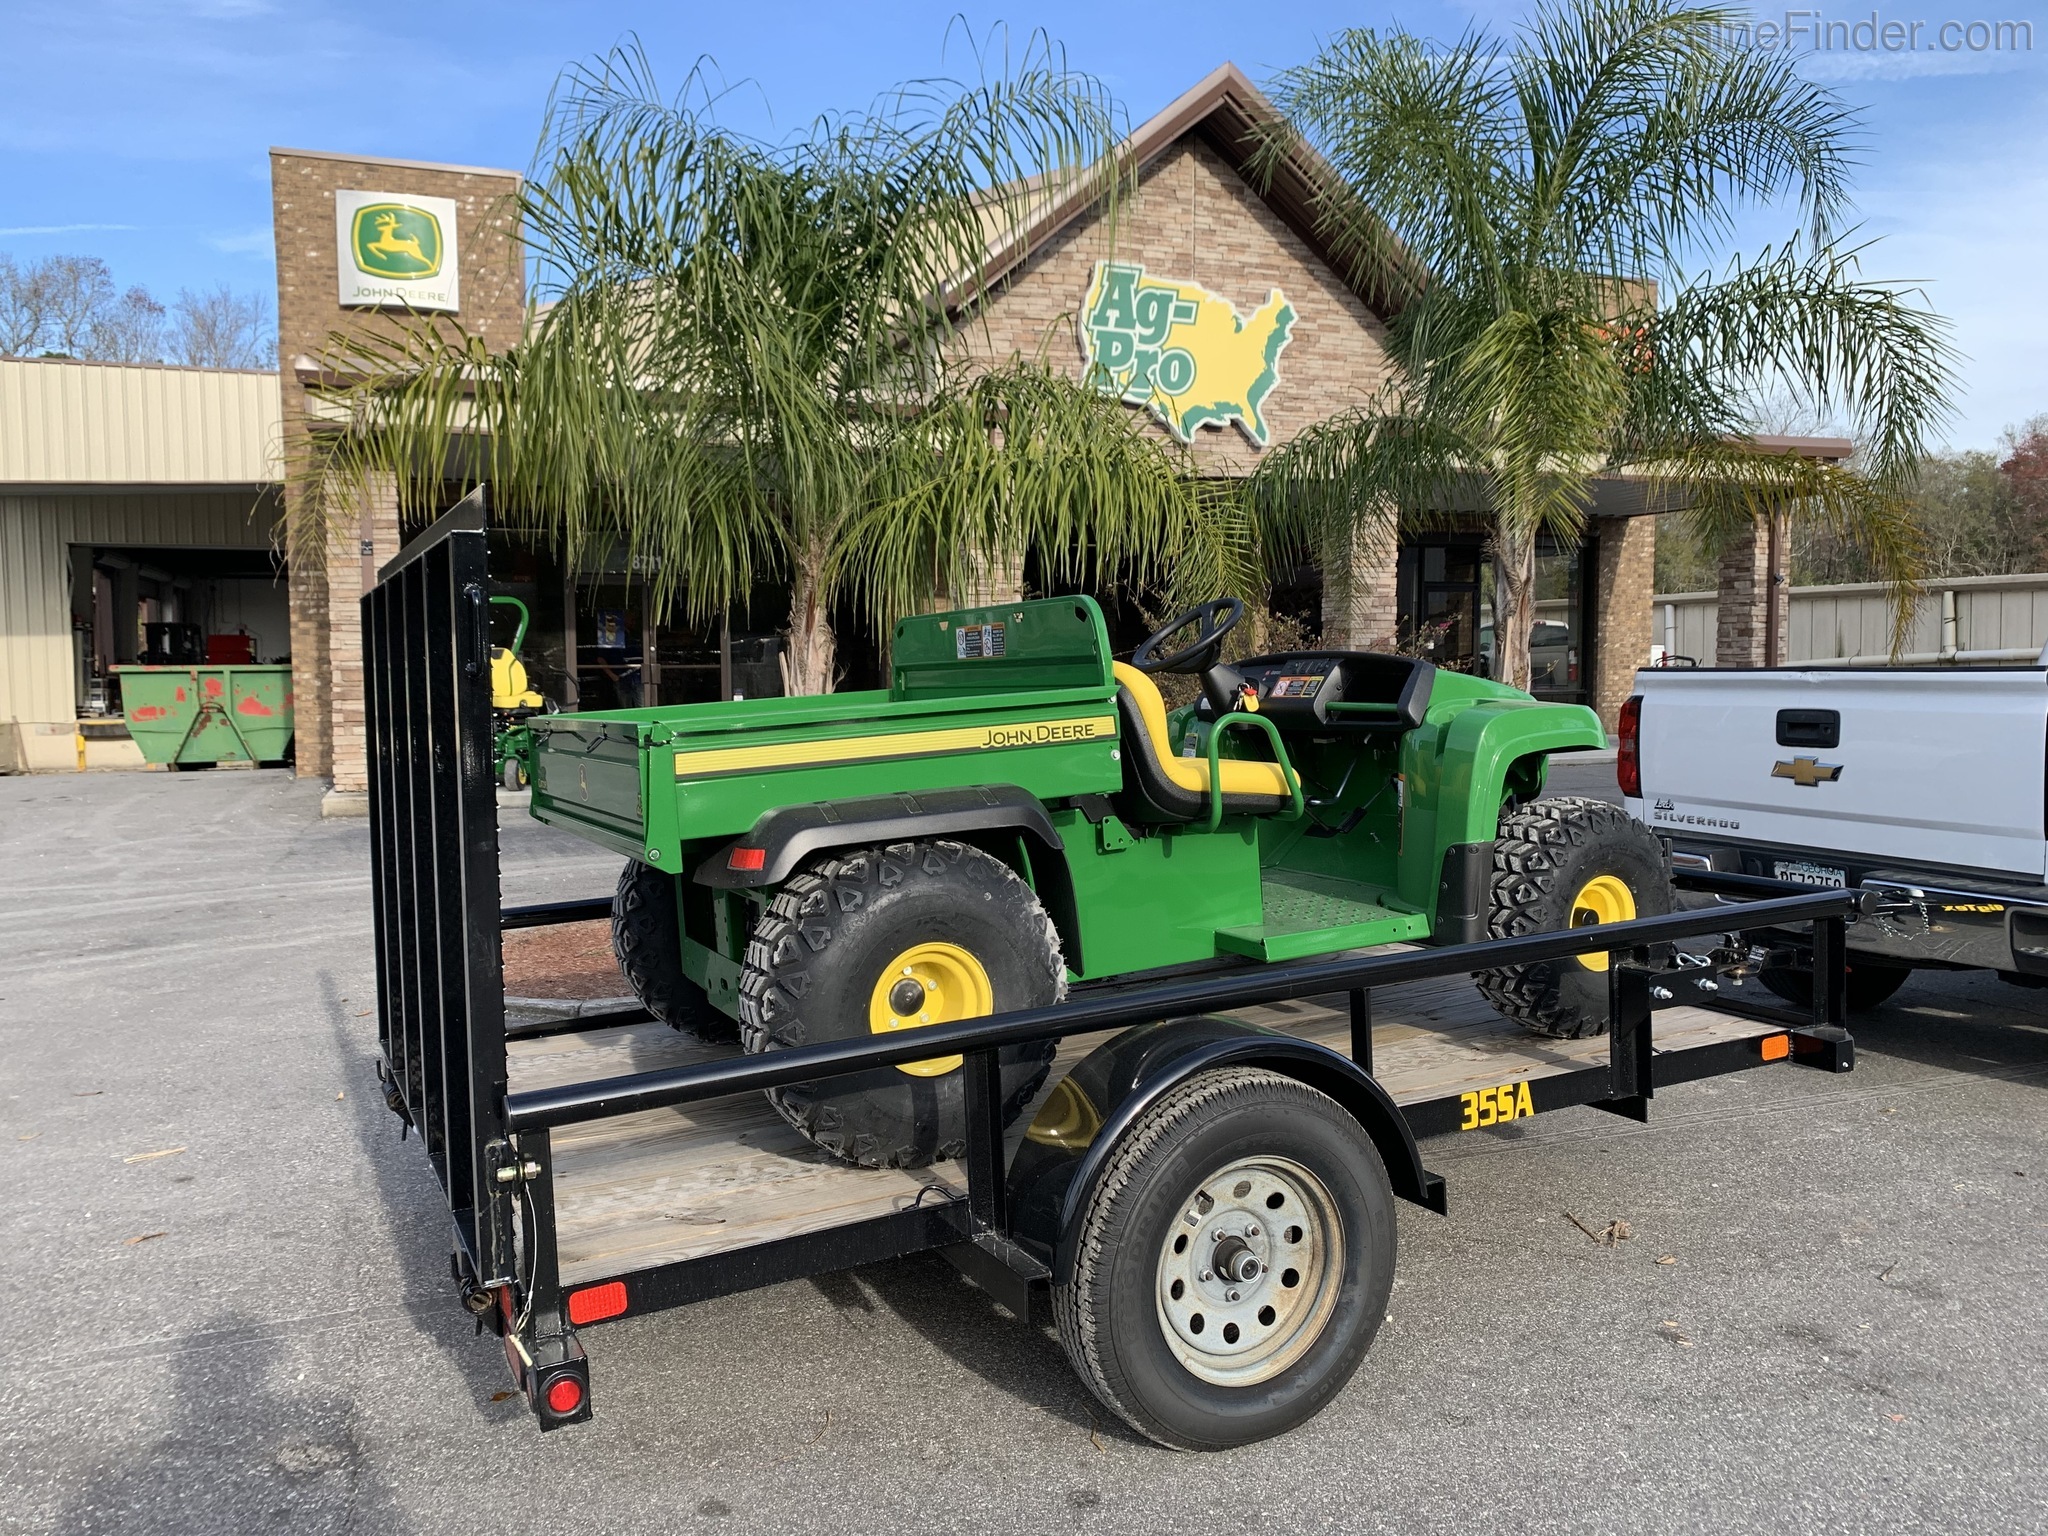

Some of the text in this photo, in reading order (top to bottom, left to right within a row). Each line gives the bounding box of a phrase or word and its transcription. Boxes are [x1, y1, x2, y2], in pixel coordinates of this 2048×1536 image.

[352, 286, 446, 302] JOHN DEERE
[1089, 265, 1198, 344] Ag-
[1090, 330, 1195, 397] Pro
[982, 724, 1095, 746] JOHN DEERE
[1653, 811, 1740, 829] SILVERADO
